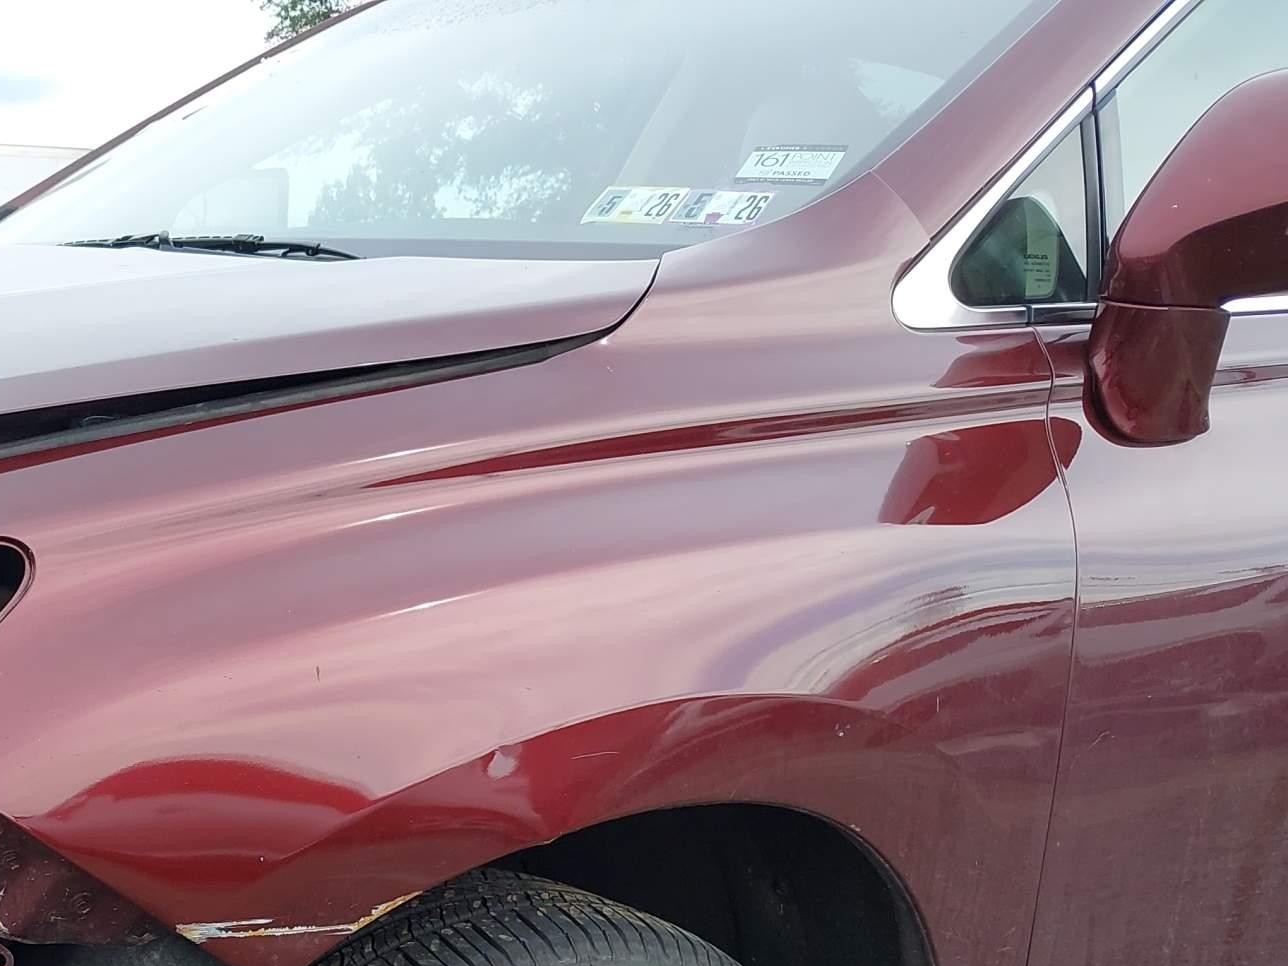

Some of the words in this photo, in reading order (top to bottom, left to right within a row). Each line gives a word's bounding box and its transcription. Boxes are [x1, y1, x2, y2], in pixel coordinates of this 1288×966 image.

[754, 152, 790, 168] 161
[644, 193, 681, 217] 26
[734, 195, 770, 220] 26
